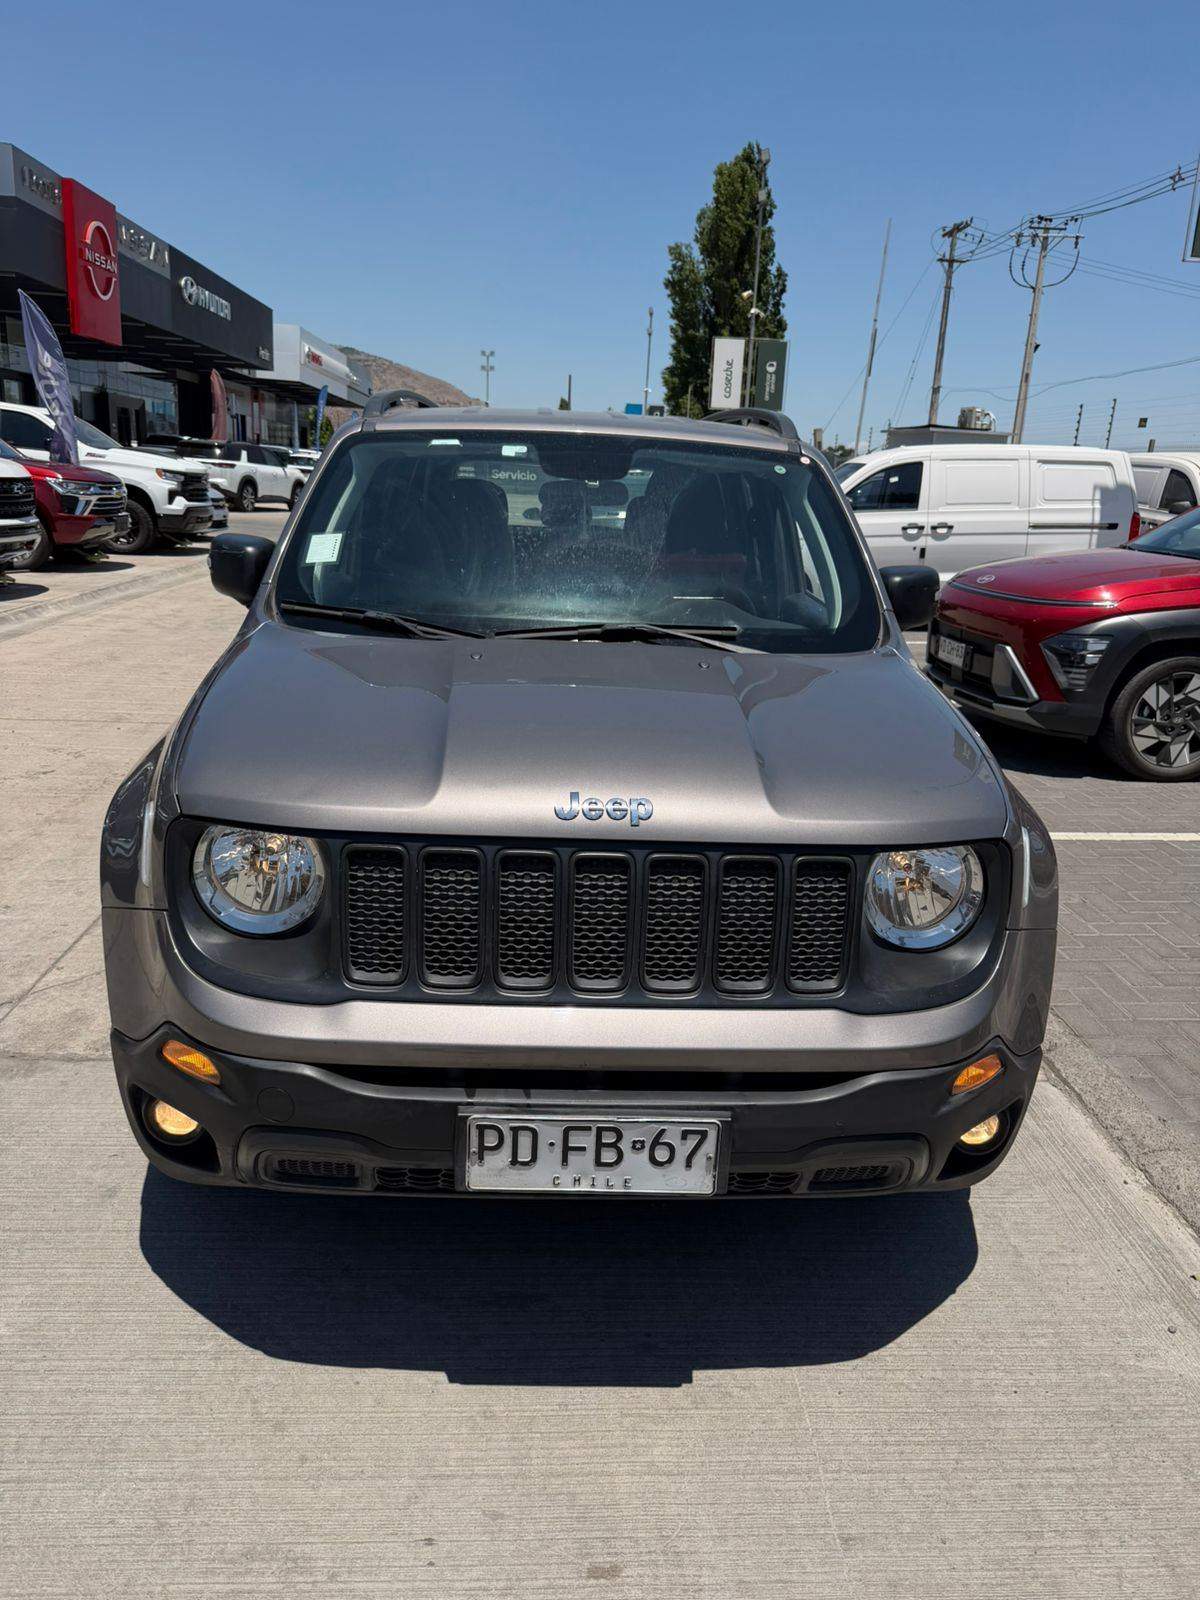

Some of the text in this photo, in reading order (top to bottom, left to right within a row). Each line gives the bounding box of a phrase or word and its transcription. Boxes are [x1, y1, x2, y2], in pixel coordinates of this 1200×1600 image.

[85, 250, 118, 275] NISSAN
[491, 468, 537, 481] Servicio
[554, 791, 653, 827] Jeep
